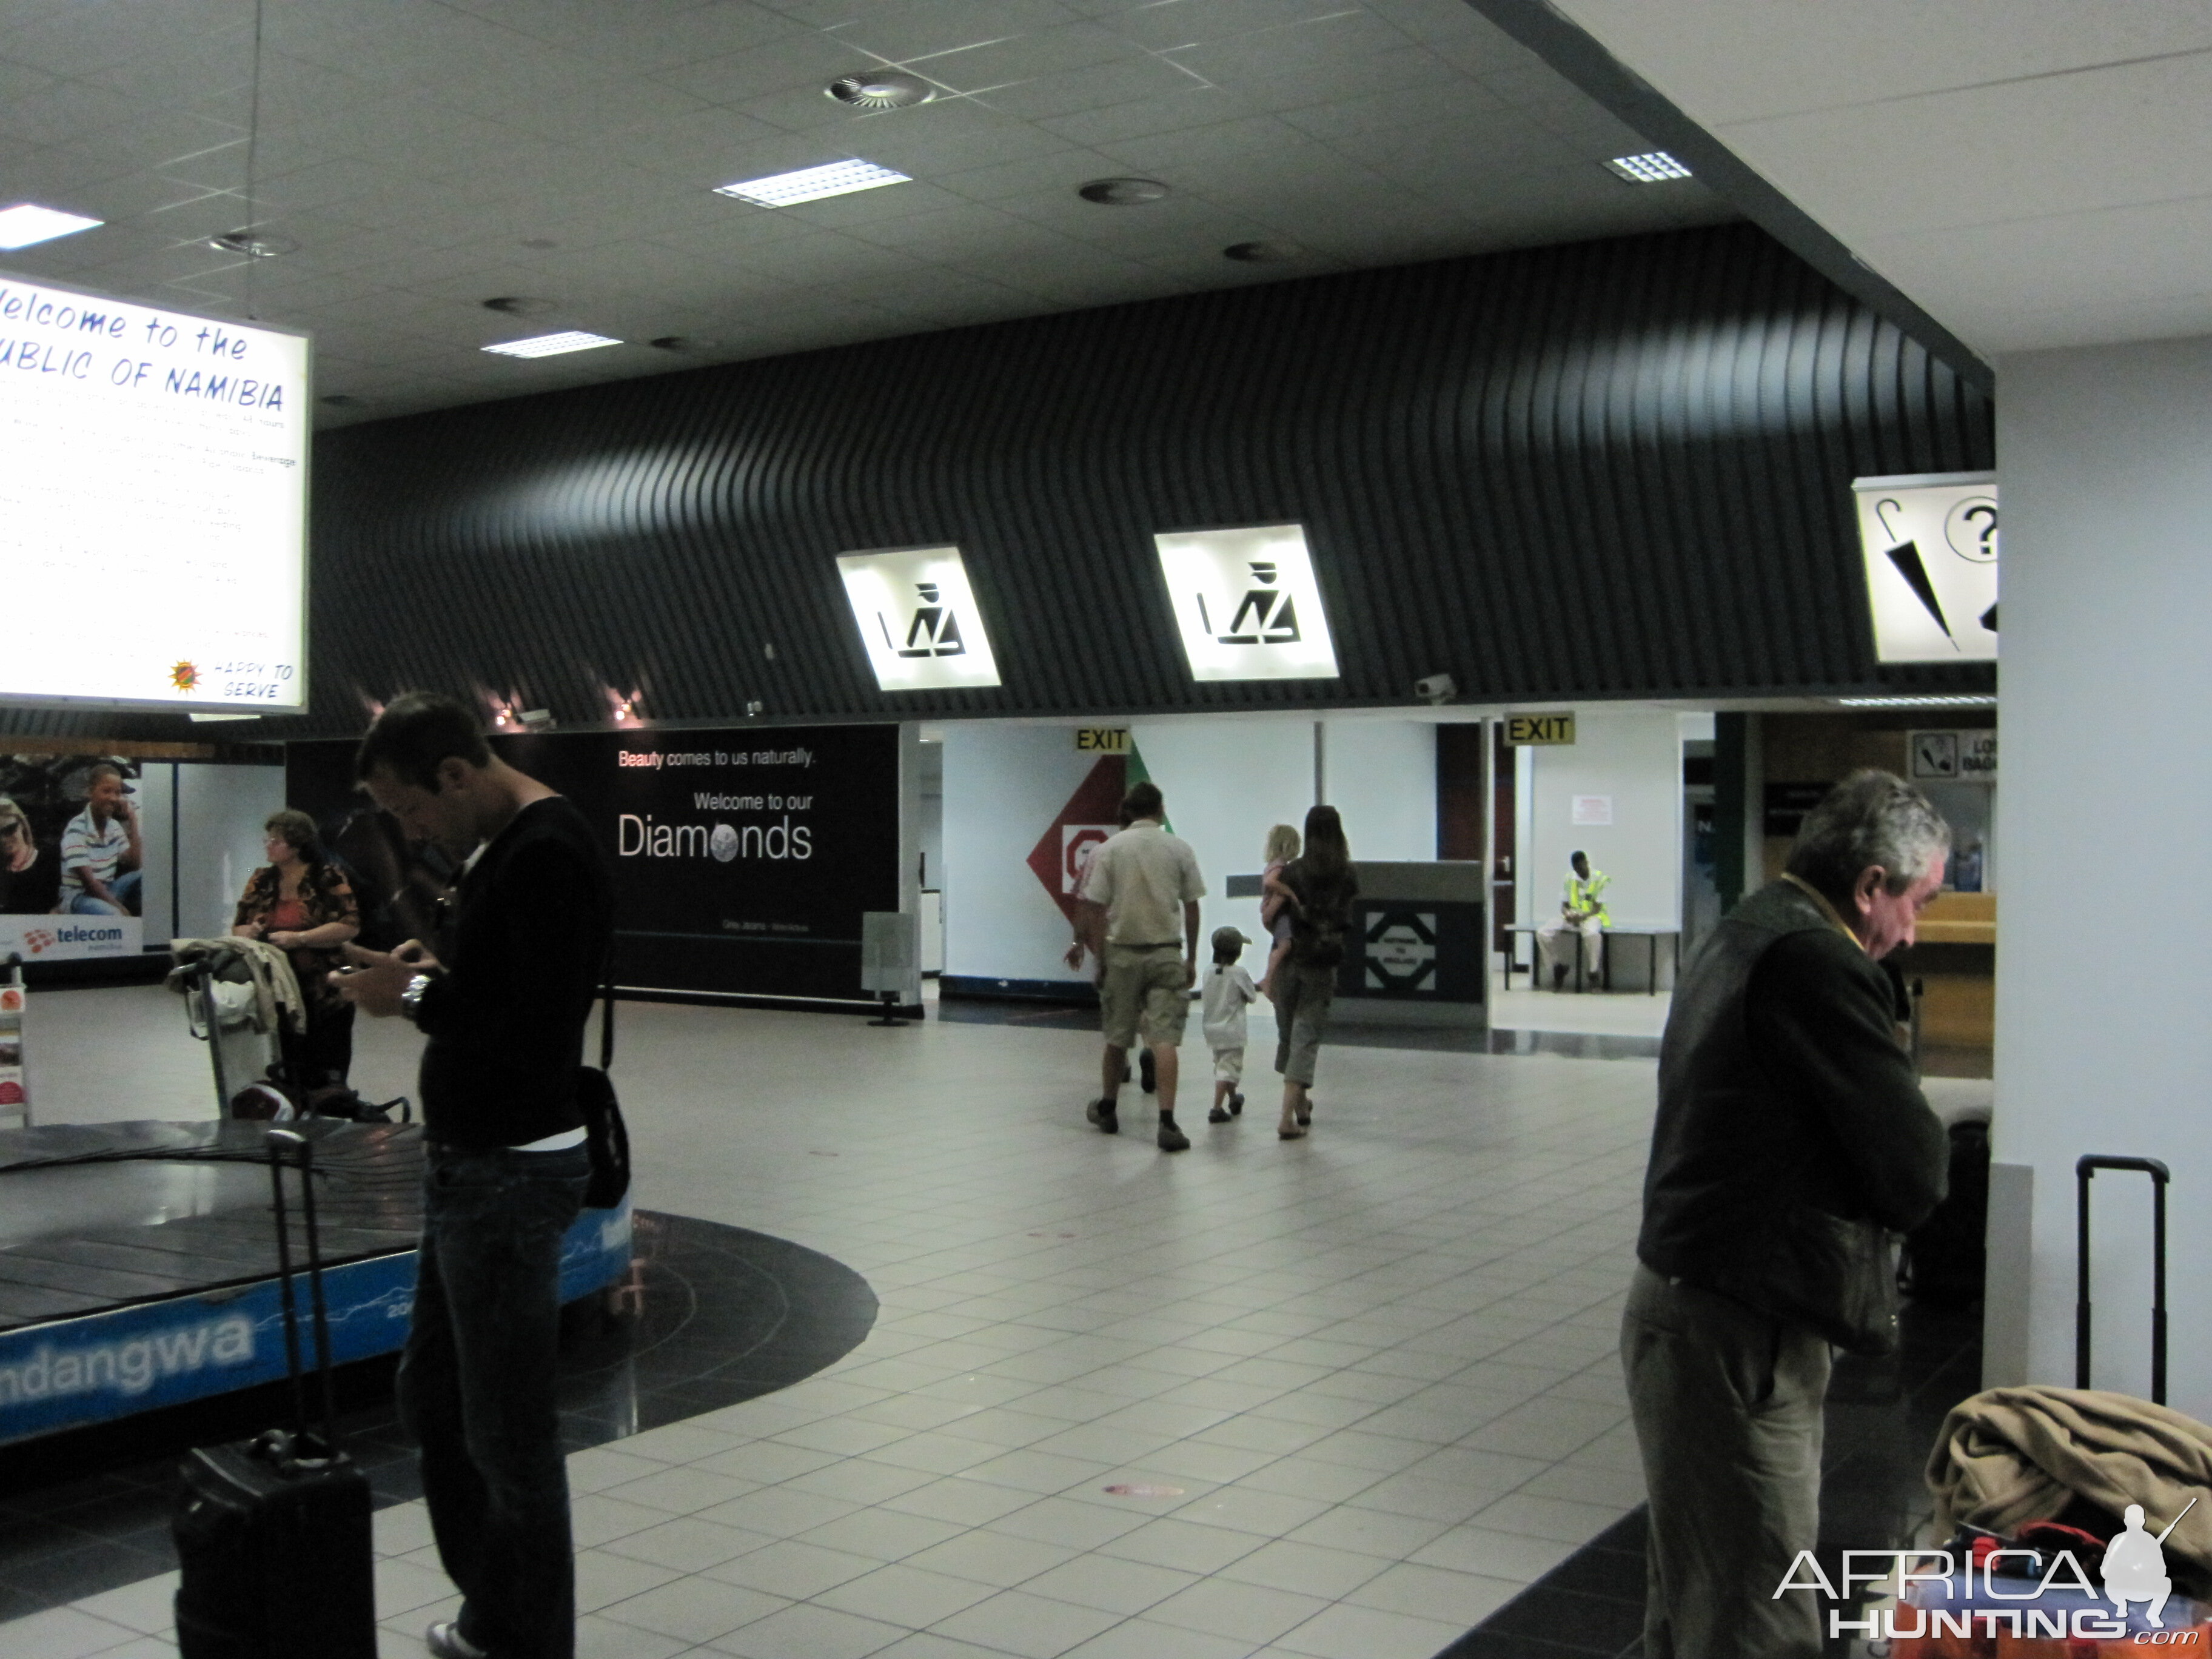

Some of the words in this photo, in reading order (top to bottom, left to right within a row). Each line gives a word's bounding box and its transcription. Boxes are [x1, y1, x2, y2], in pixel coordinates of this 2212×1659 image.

[147, 317, 178, 347] to
[195, 326, 247, 360] the
[112, 358, 152, 388] OF
[165, 367, 283, 412] NAMIBIA
[275, 665, 293, 680] TO
[224, 682, 279, 699] SERVE
[1078, 729, 1127, 749] EXIT
[1509, 717, 1569, 740] EXIT
[618, 751, 664, 770] Beauty
[667, 752, 711, 766] comes
[715, 750, 728, 765] to
[732, 752, 748, 765] us
[752, 748, 816, 768] naturally.
[694, 793, 763, 809] Welcome
[768, 793, 783, 809] to
[788, 796, 813, 809] our
[618, 814, 813, 862] Diamonds
[58, 925, 121, 942] telecom
